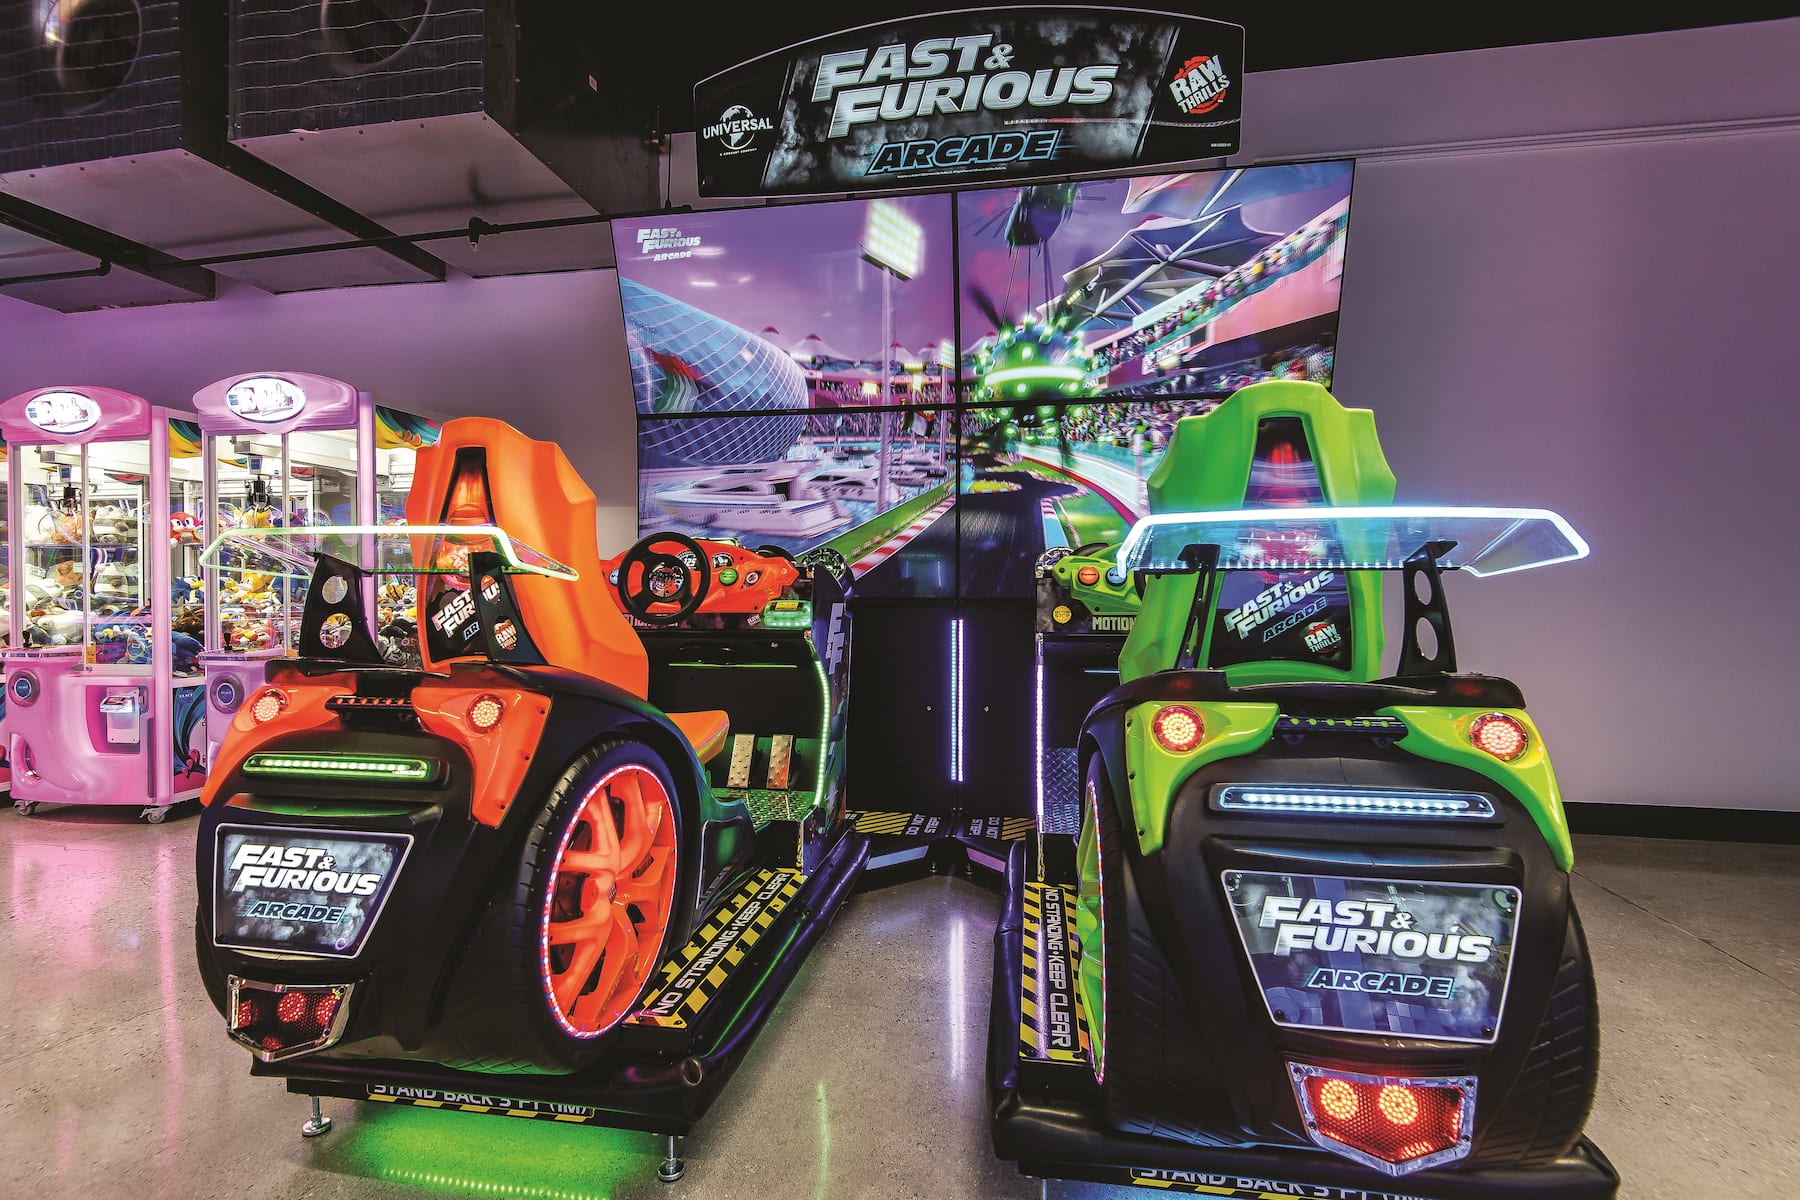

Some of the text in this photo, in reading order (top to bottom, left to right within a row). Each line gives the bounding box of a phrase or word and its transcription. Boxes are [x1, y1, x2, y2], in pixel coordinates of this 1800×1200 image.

[812, 33, 994, 102] FAST
[1168, 54, 1223, 103] RAW
[827, 64, 1122, 139] FURIOUS
[1178, 74, 1231, 114] THRILLS
[702, 117, 774, 140] UNIVERSAL
[864, 130, 1060, 176] ARCADE
[636, 228, 678, 244] FAST
[642, 236, 701, 254] FURIOUS
[653, 250, 692, 262] ARCADE
[1223, 581, 1284, 632] FAST
[1236, 570, 1335, 640] FURIOUS
[1263, 596, 1327, 643] ARCADE
[1303, 623, 1338, 647] RAW
[1309, 633, 1342, 653] THRILLS
[229, 844, 327, 870] FAST
[232, 866, 382, 896] FURIOUS
[246, 900, 347, 925] ARCADE
[1258, 895, 1397, 929] FAST
[651, 991, 683, 1014] NO
[675, 929, 740, 990] STANDING
[731, 901, 762, 927] KEEP
[756, 872, 790, 901] CLEAR
[1273, 923, 1493, 963] FURIOUS
[1045, 888, 1072, 1050] NO STANDING KEEP CLEAR
[1306, 966, 1455, 999] ARCADE
